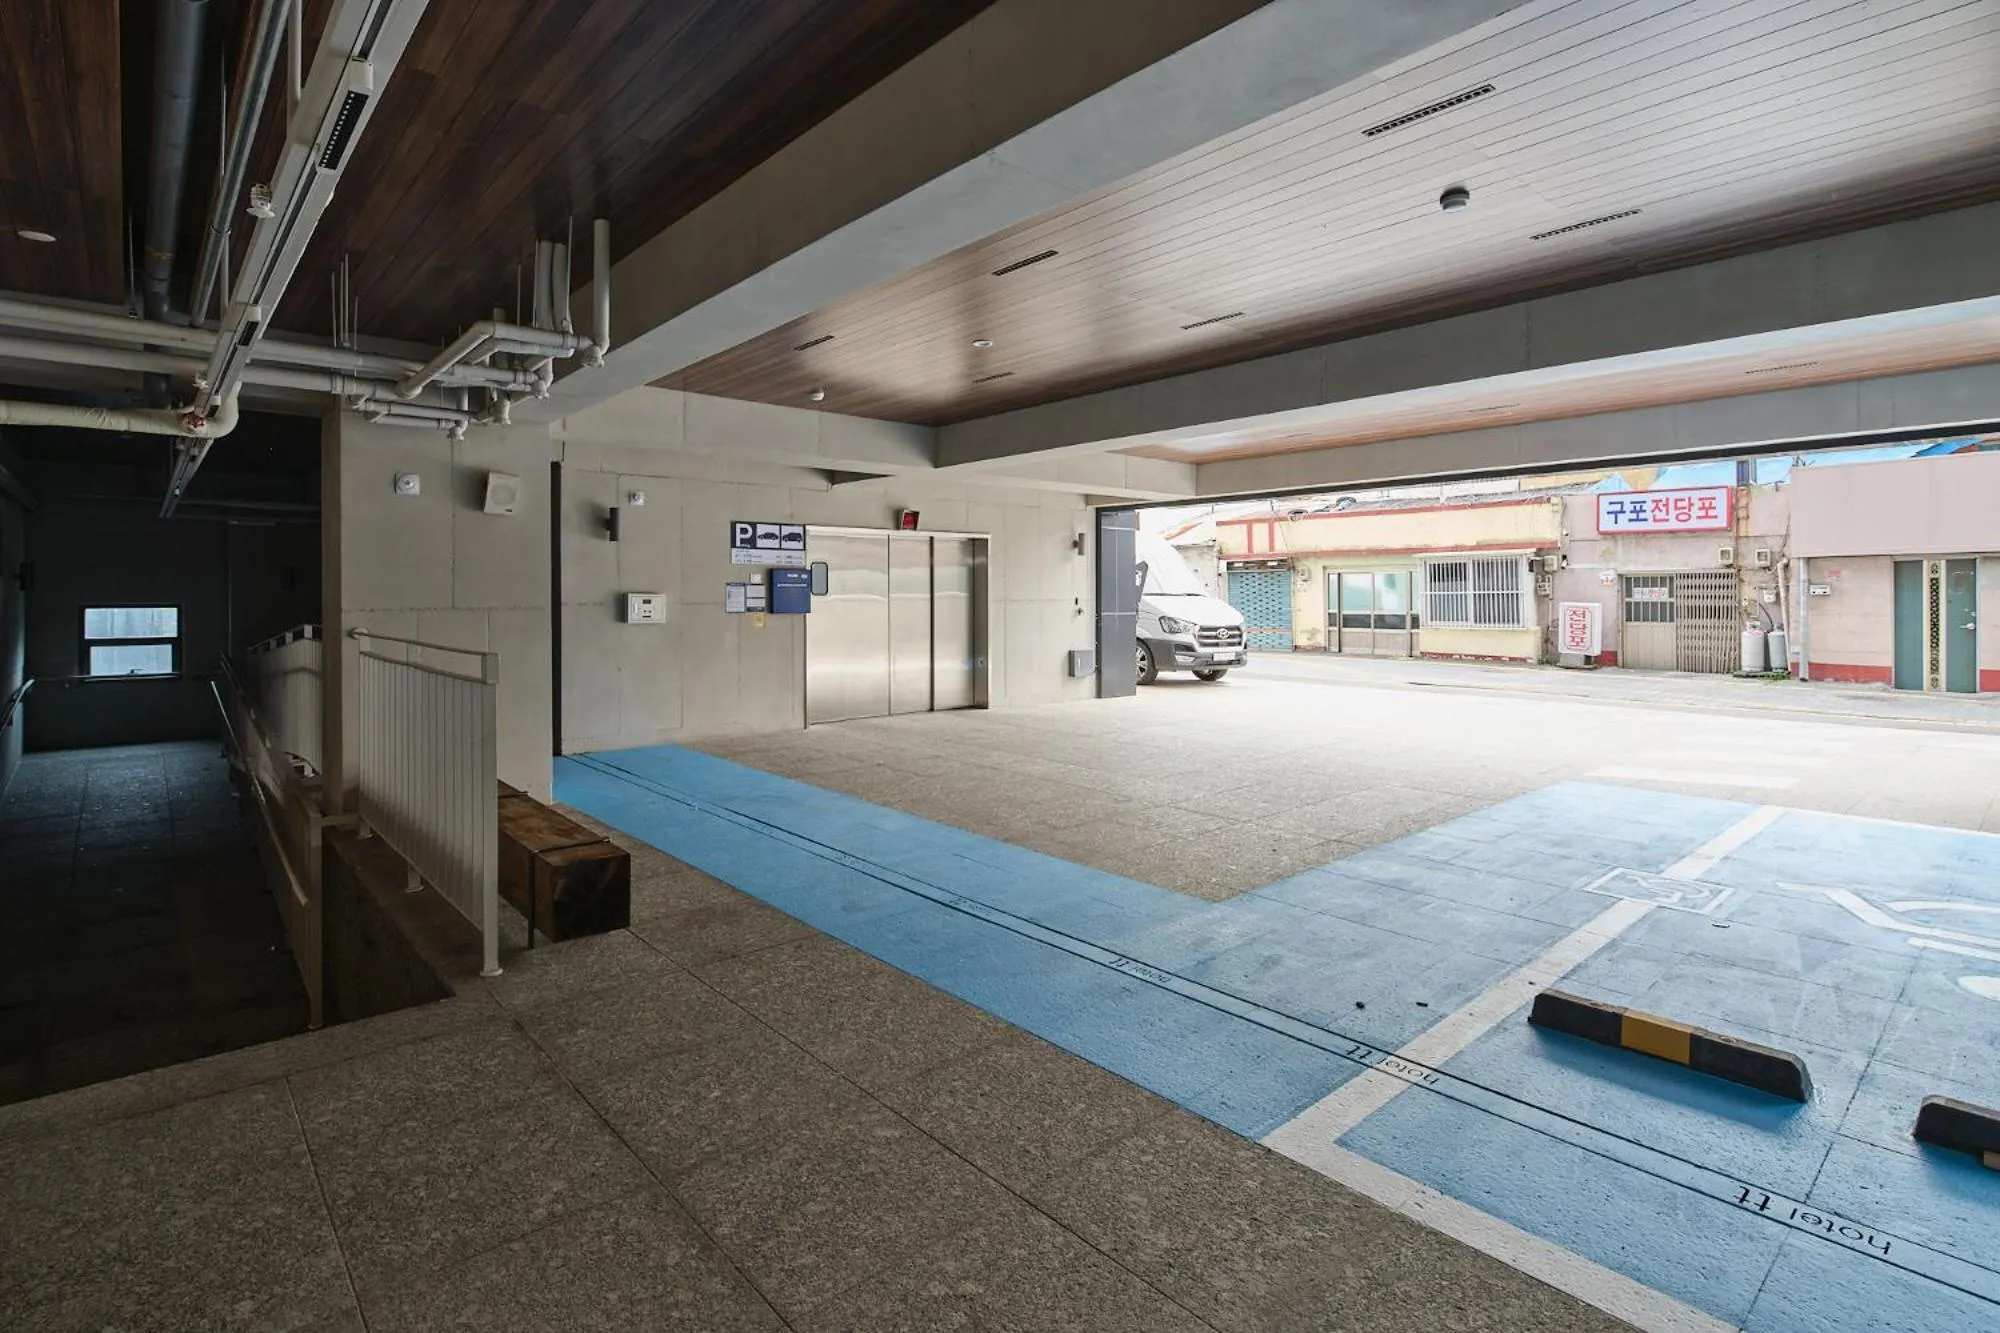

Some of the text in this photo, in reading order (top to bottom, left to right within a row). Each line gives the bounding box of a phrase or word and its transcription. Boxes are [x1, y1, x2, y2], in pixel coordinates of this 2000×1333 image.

[735, 523, 753, 547] P
[1376, 1057, 1440, 1085] hotel
[1732, 1185, 1892, 1255] hotel tt
